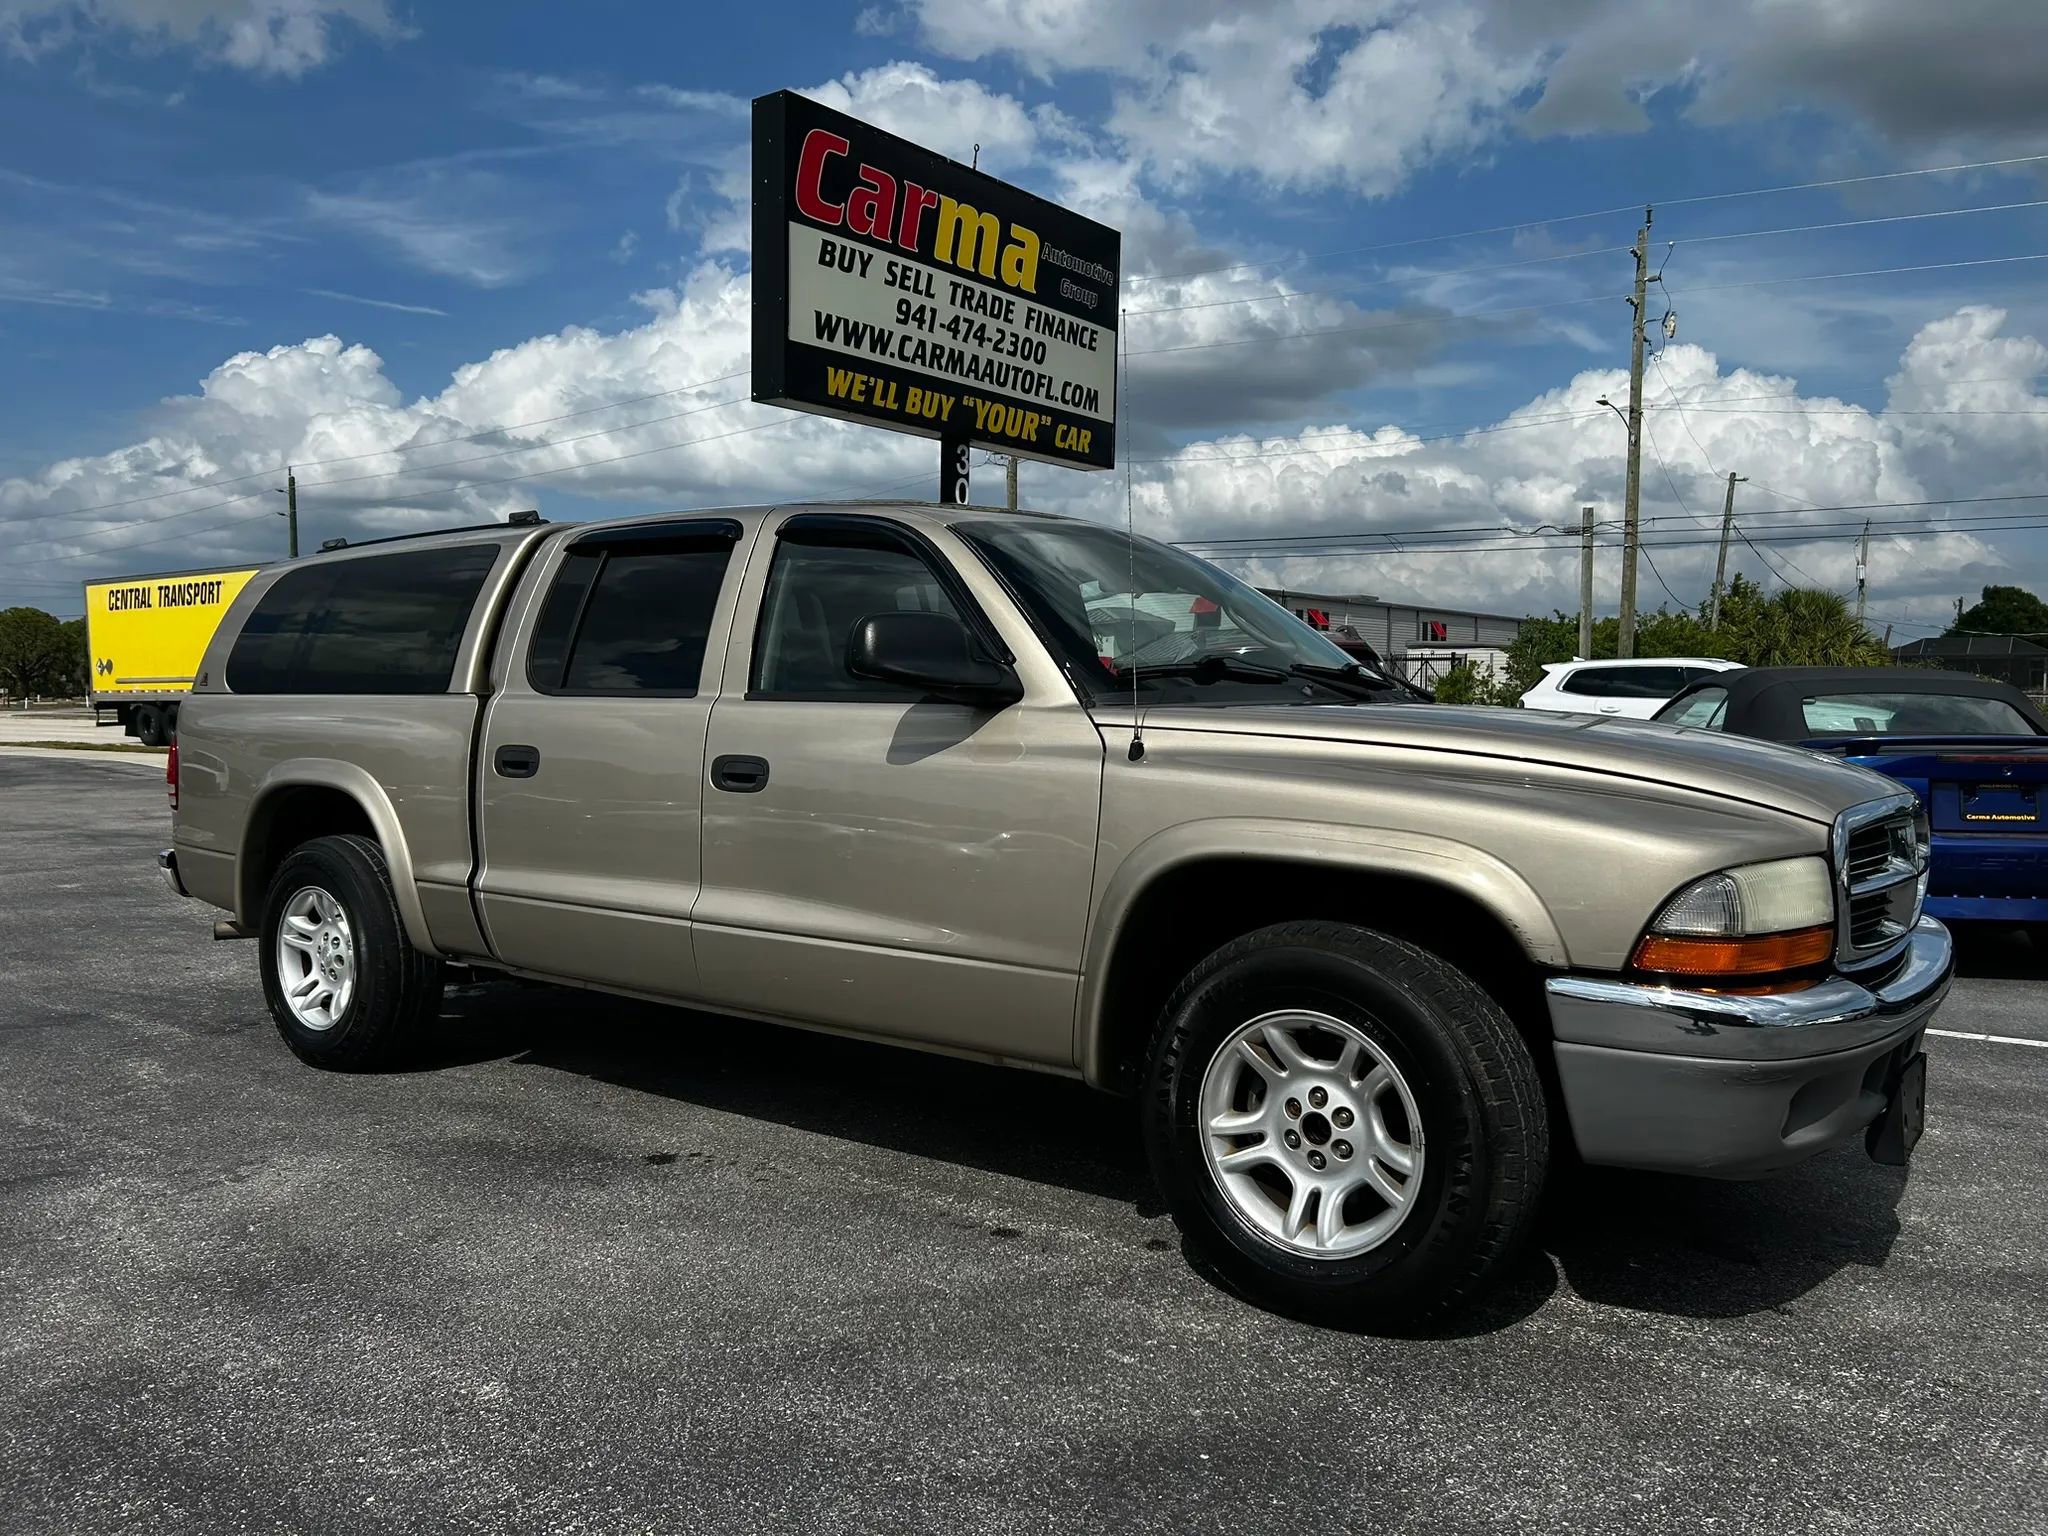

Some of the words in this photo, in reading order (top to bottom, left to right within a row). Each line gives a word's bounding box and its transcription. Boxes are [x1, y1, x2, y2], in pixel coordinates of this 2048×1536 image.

[796, 129, 1040, 294] Carma
[818, 238, 874, 279] BUY
[884, 260, 936, 299] SELL
[949, 281, 1015, 325] TRADE
[1025, 306, 1098, 352] FINANCE
[1041, 242, 1114, 287] Automotive
[1060, 279, 1098, 309] Group
[814, 310, 1100, 414] WWW.CARMAAUTOFL.COM
[896, 298, 1047, 366] 941-474-2300
[826, 366, 899, 411] WE'LL
[908, 385, 955, 422] BUY
[1055, 424, 1092, 454] CAR
[108, 586, 152, 611] CENTRAL
[157, 580, 222, 608] TRANSPORT
[1966, 813, 1991, 821] Carma
